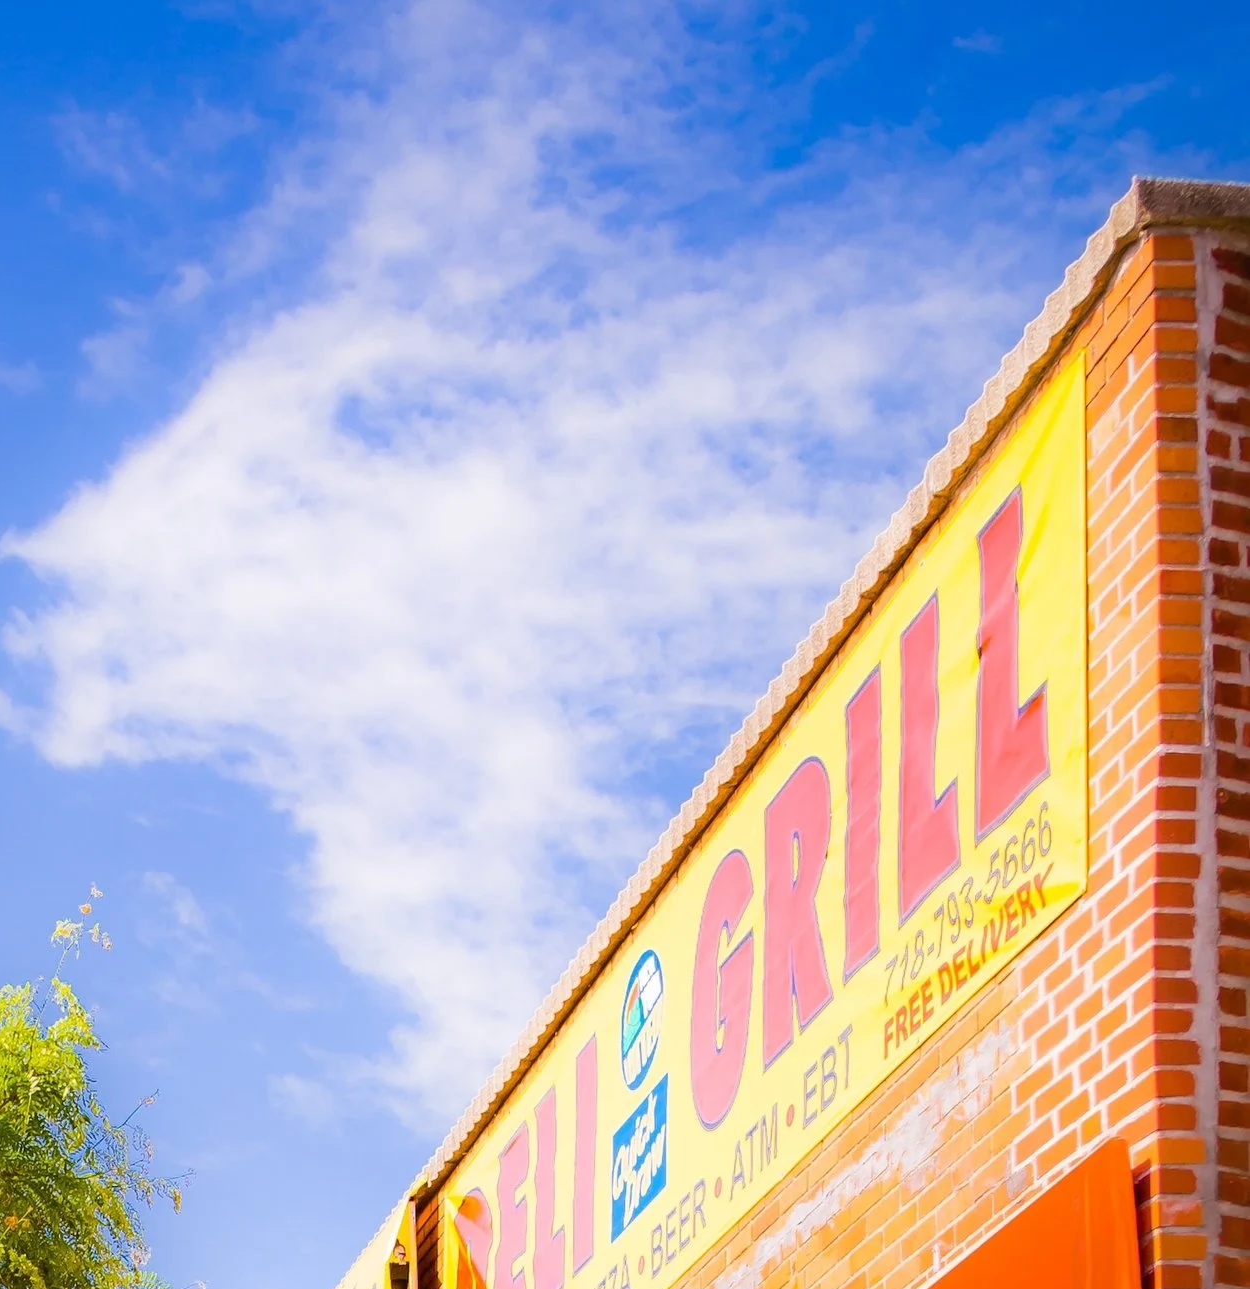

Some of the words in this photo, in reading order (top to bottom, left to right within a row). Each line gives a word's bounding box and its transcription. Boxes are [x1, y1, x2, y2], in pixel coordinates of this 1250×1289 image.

[690, 484, 1051, 1132] GRILL
[883, 801, 1053, 1007] 718-793-5666
[883, 978, 935, 1061] FREE
[937, 862, 1055, 1004] DELIVERY
[651, 1178, 707, 1280] BEER
[729, 1102, 778, 1202] ATM
[802, 1023, 854, 1130] EBT
